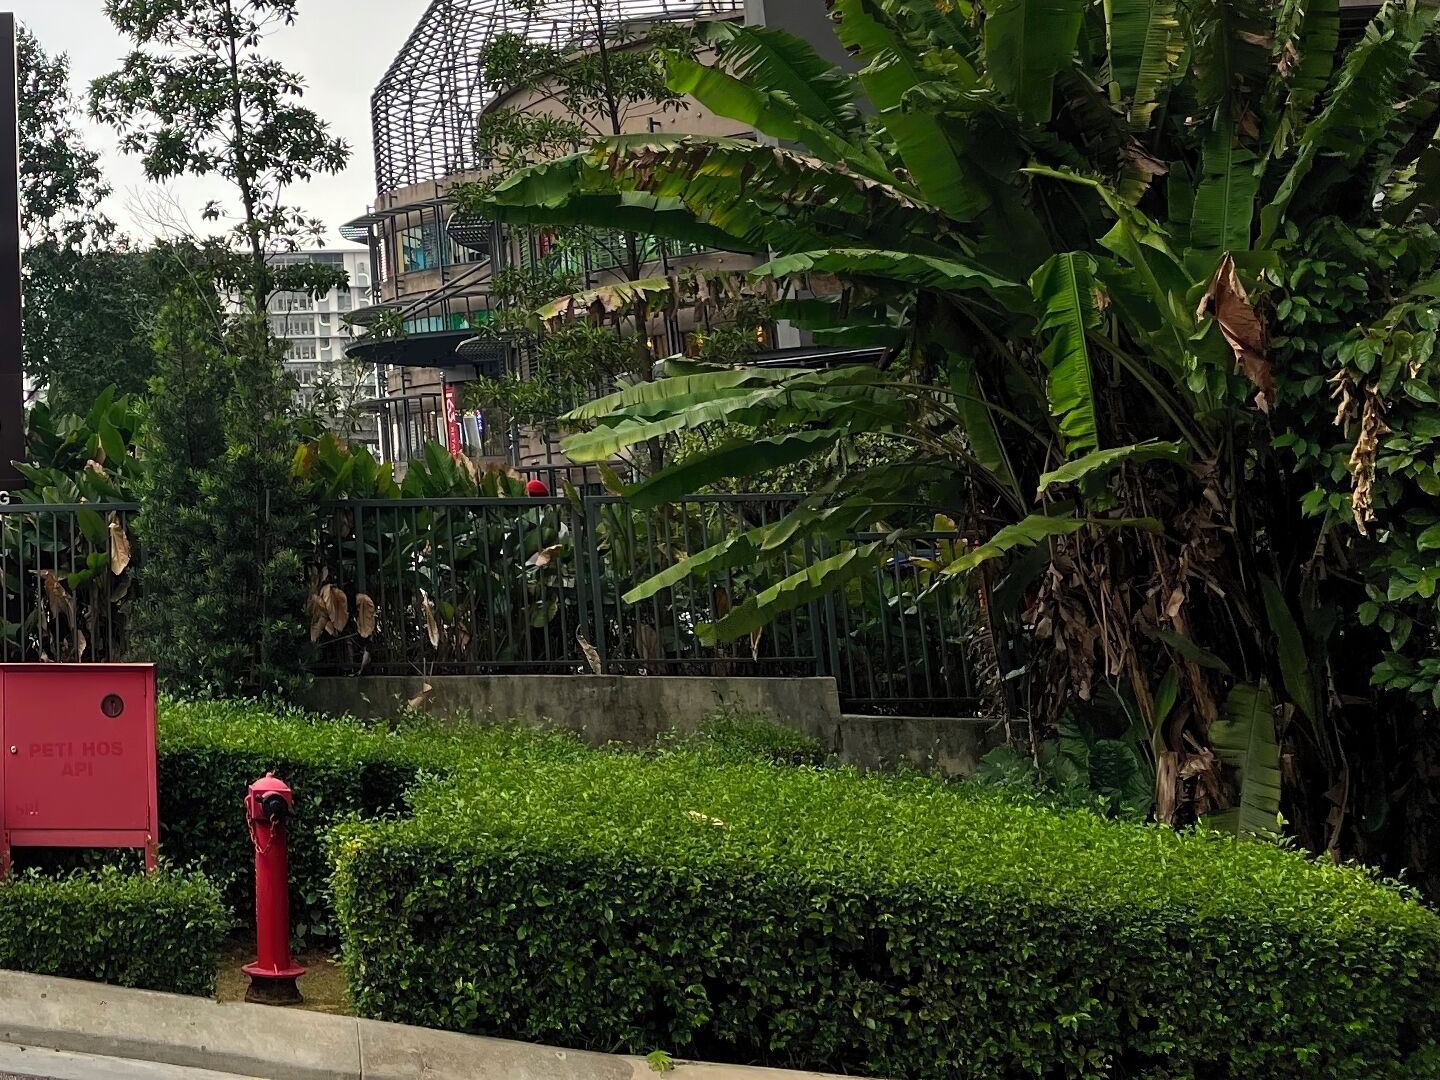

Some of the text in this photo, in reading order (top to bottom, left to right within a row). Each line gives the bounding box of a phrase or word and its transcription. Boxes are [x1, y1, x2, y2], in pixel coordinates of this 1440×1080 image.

[29, 741, 124, 758] PETI HOS
[61, 761, 94, 777] API
